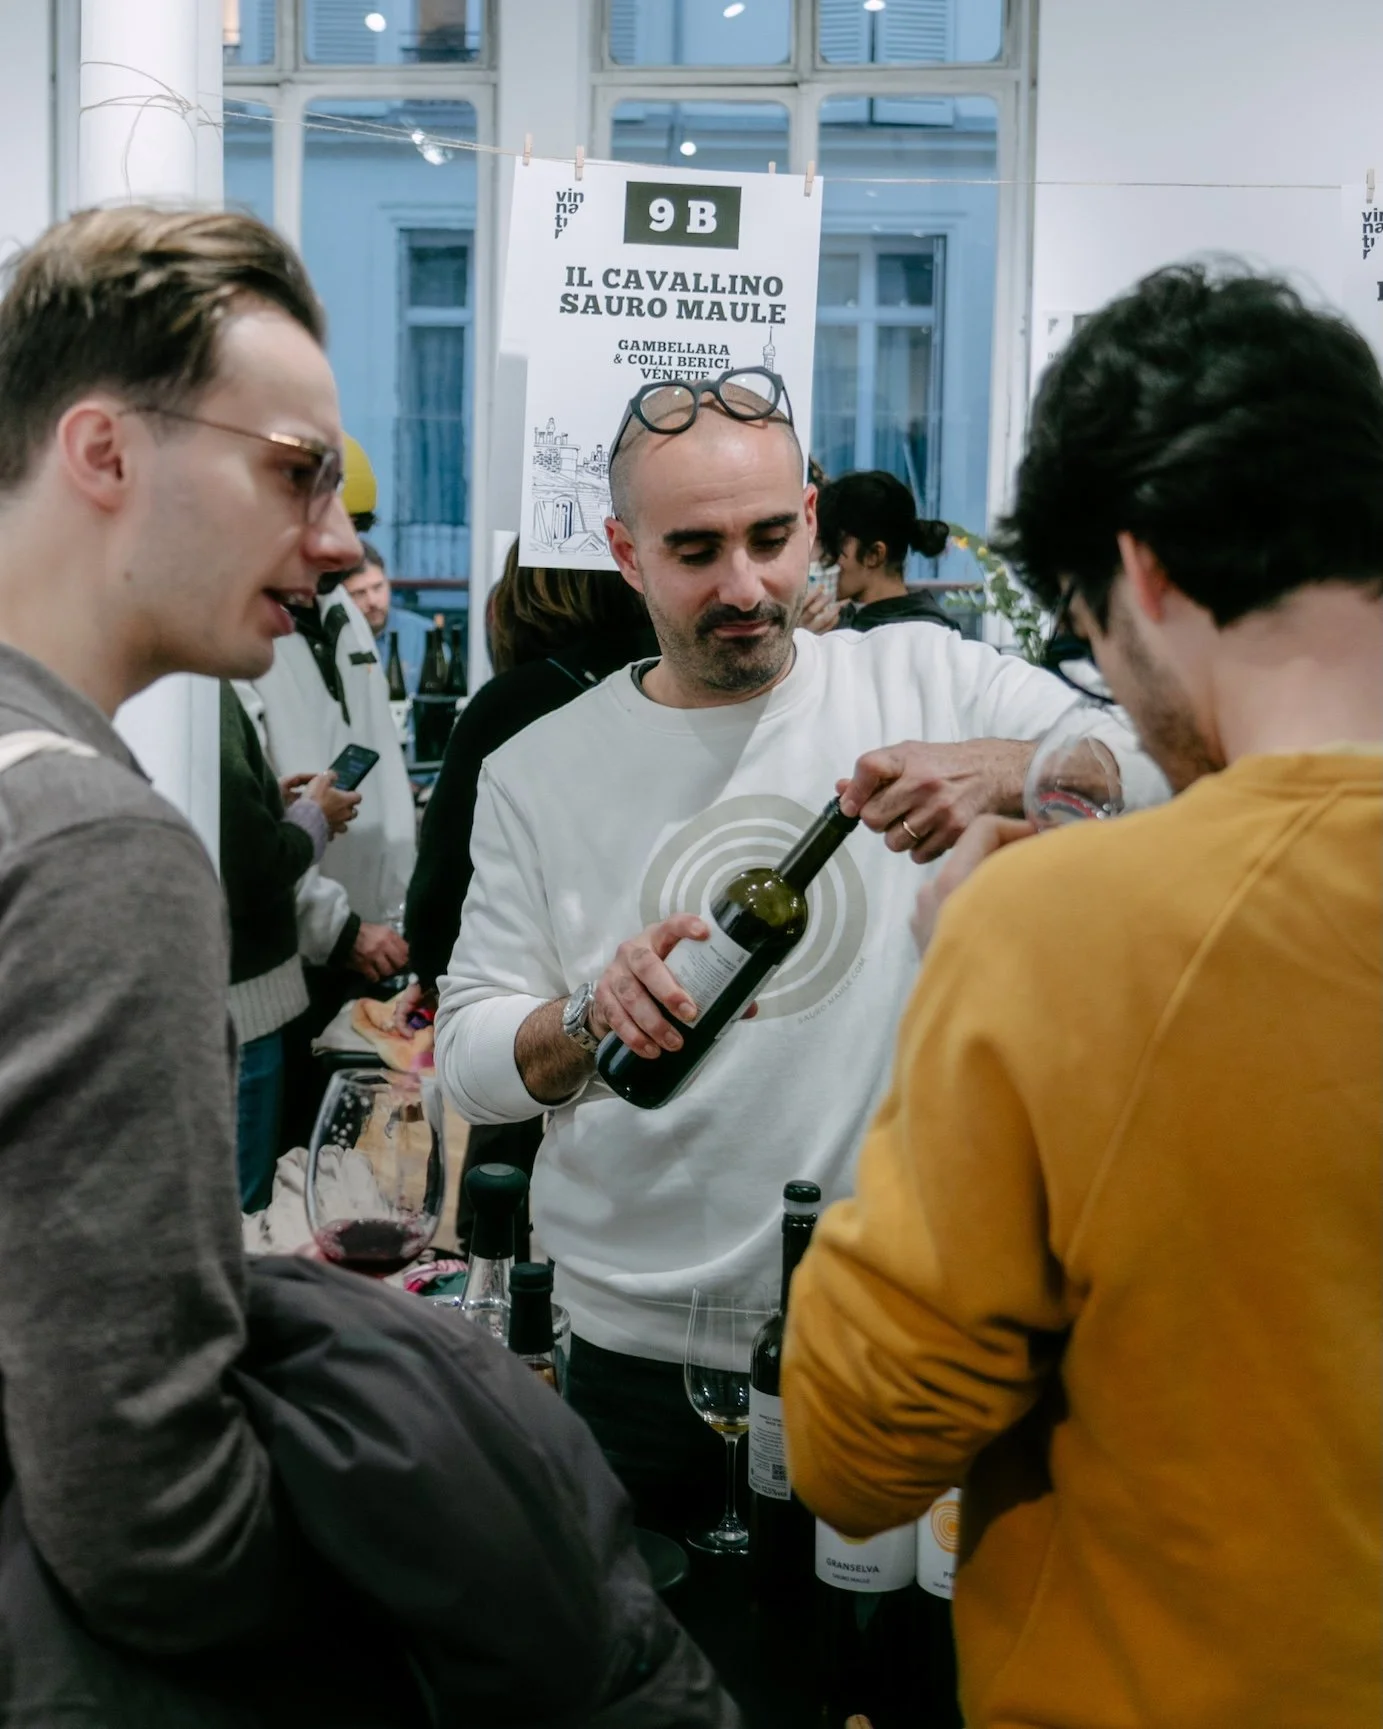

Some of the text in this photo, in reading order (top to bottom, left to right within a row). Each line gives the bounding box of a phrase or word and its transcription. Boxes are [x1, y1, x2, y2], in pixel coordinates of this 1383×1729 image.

[556, 188, 585, 203] vin
[649, 198, 717, 234] 9 B
[565, 266, 784, 297] IL CAVALLINO
[560, 293, 787, 324] SAURO MAULE
[618, 339, 731, 355] GAMBELLARA
[613, 353, 735, 371] & COLLI BERICI,
[826, 1557, 880, 1573] GRANSELVA
